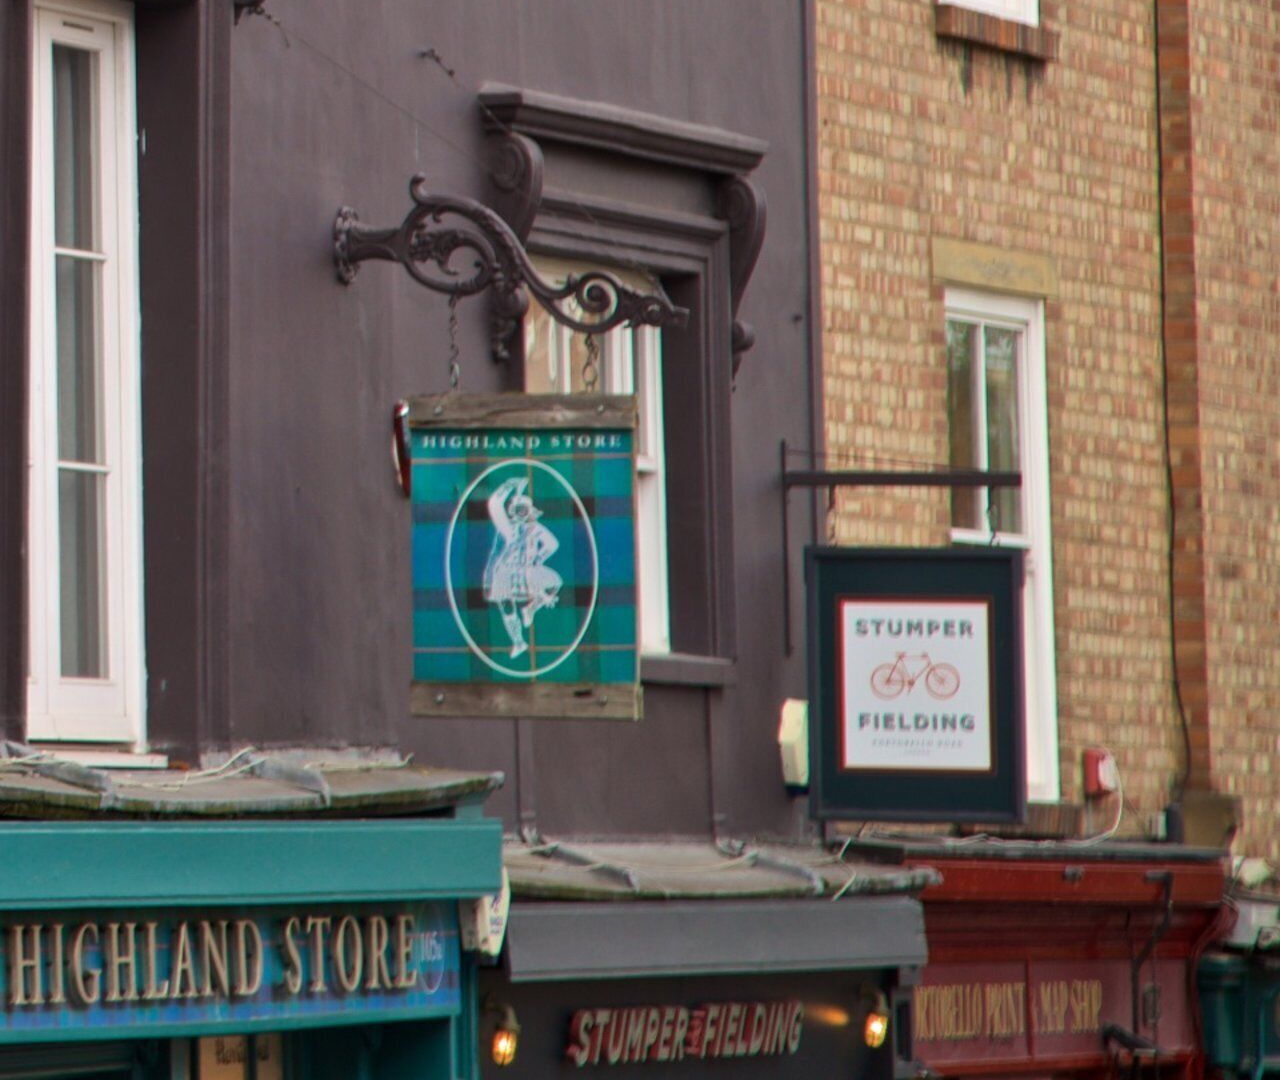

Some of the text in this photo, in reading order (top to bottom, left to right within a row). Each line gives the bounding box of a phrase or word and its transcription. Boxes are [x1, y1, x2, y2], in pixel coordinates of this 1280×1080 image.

[422, 433, 622, 449] HIGHLAND STORE
[855, 619, 974, 637] STUMPER
[858, 712, 975, 731] FIELDING
[8, 913, 418, 1007] HIGHLAND STORE
[567, 1006, 690, 1068] STUMPER
[700, 1000, 804, 1059] FIELDING
